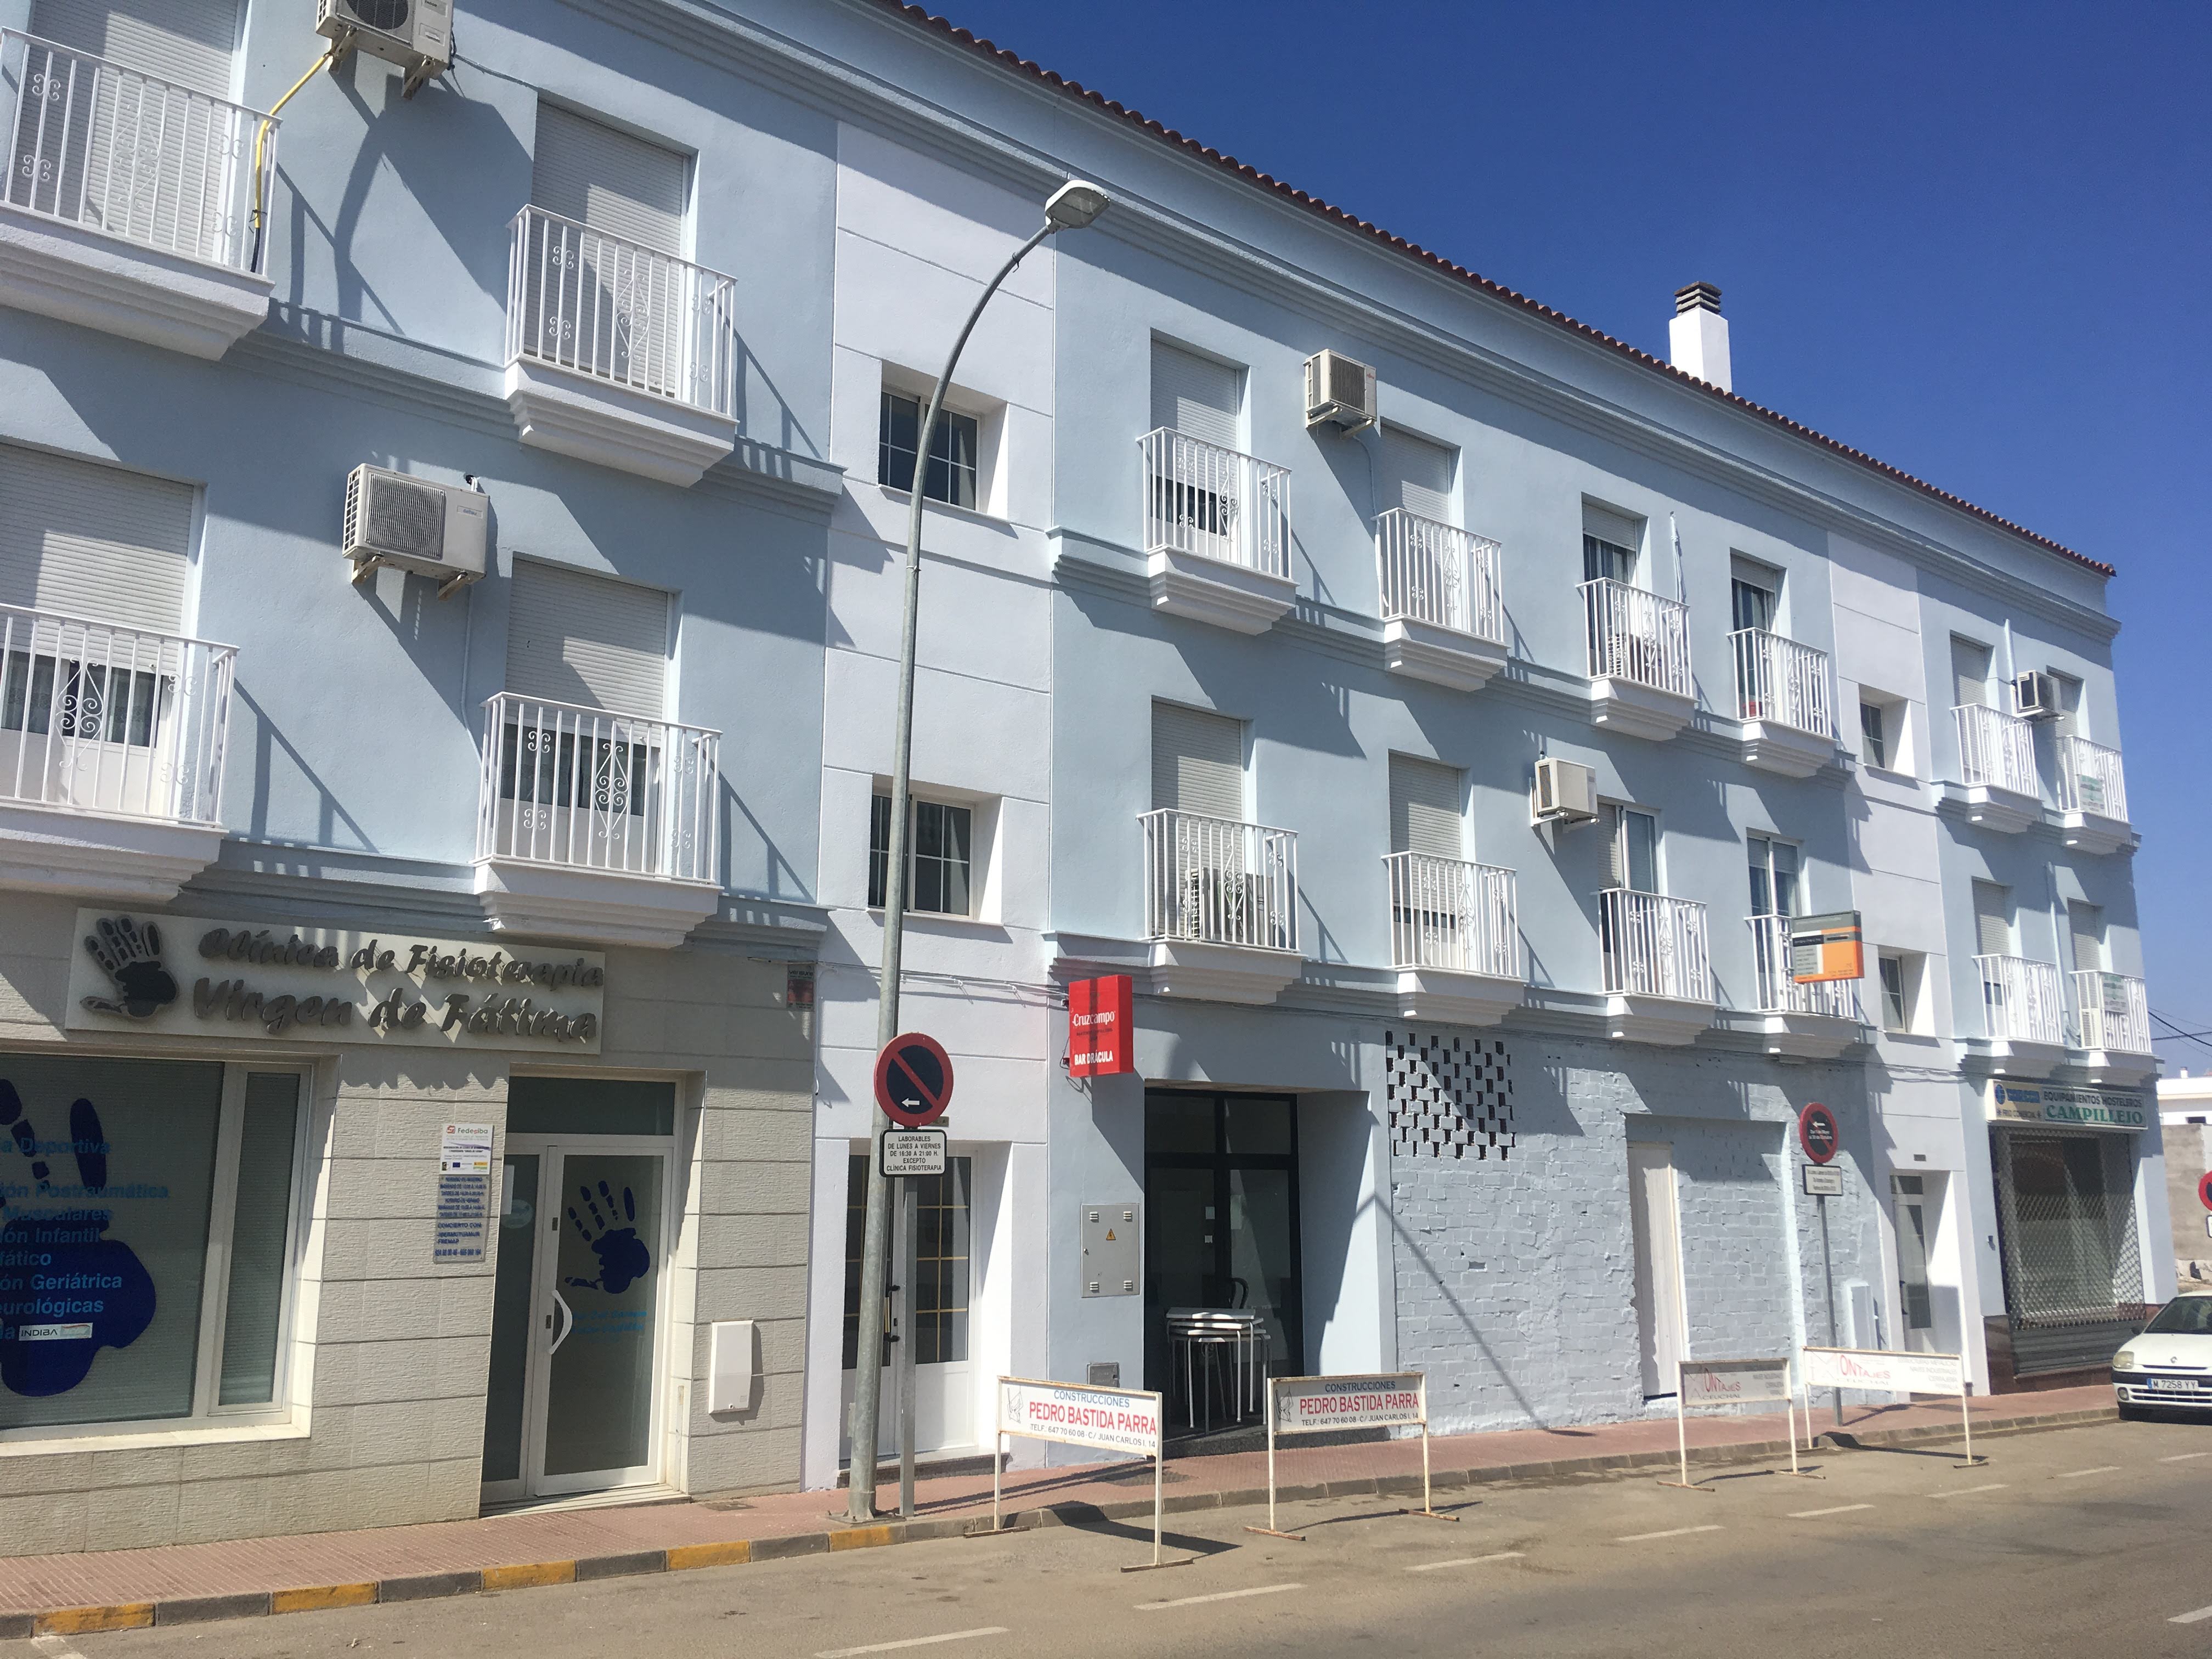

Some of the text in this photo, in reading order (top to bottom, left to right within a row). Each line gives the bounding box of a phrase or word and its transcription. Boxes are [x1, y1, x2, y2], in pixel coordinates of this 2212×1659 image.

[198, 928, 603, 991] Clínica de Fisioterapia
[193, 977, 597, 1042] Virgen de Fátima
[1073, 1011, 1115, 1027] Cruzcampo
[1074, 1049, 1114, 1065] BAR DRÁCULA
[2044, 1091, 2101, 1105] EQUIPAMIENTOS
[2102, 1097, 2143, 1108] HOSTELEROS
[2046, 1105, 2143, 1124] CAMPILLEJO
[20, 1137, 110, 1155] Deportiva
[35, 1227, 100, 1243] Infantil
[30, 1272, 122, 1290] Geriátrica
[21, 1329, 58, 1337] INDIBA
[1325, 1380, 1396, 1393] CONSTRUCCIONES
[2153, 1380, 2196, 1390] M 7258 YY
[1054, 1390, 1130, 1408] CONSTRUCCIONES
[1300, 1392, 1419, 1415] PEDRO BASTIDA PARRA
[1029, 1401, 1157, 1436] PEDRO BASTIDA PARRA
[1098, 1434, 1115, 1442] JUAN
[1115, 1436, 1142, 1446] CARLOS
